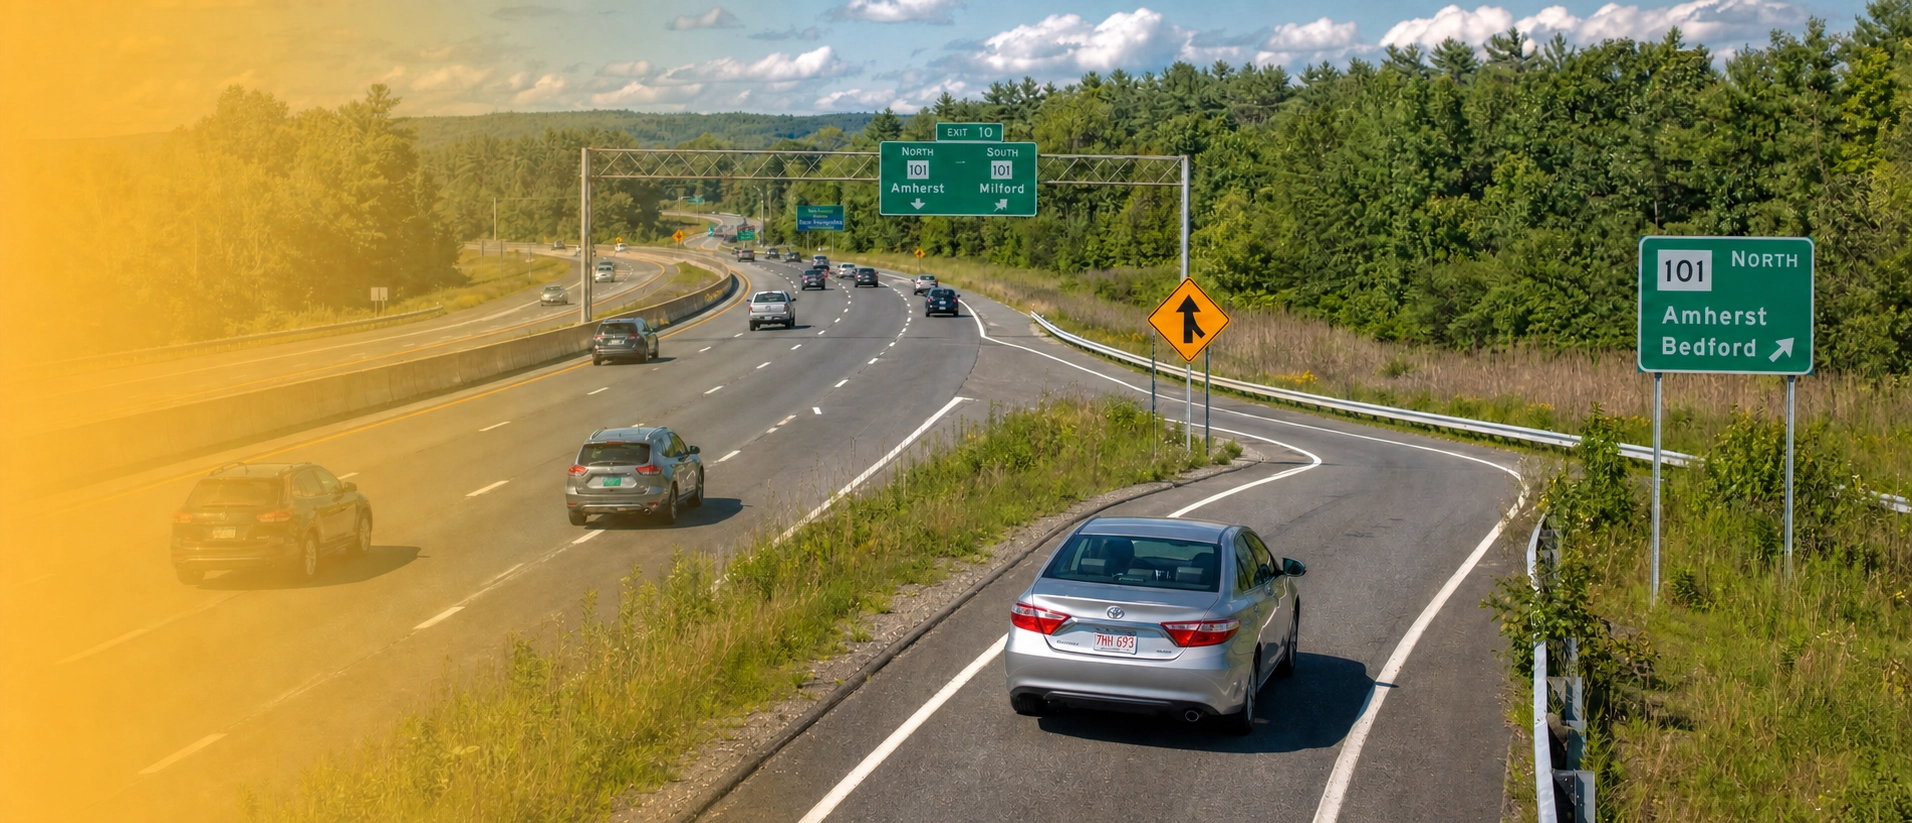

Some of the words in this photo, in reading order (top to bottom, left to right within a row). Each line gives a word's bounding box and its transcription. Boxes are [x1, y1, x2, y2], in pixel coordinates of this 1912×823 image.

[948, 128, 968, 137] EXIT
[979, 127, 993, 138] 10
[902, 147, 934, 156] NORTH
[987, 147, 1018, 157] SOUTH
[909, 164, 927, 176] 101
[993, 164, 1010, 176] 101
[891, 183, 945, 193] Amherst
[980, 183, 1025, 194] Milford
[1665, 259, 1703, 283] 101
[1731, 250, 1798, 268] NORTH
[1662, 305, 1767, 326] Amherst
[1662, 336, 1756, 357] Bedford
[1116, 636, 1134, 648] 693
